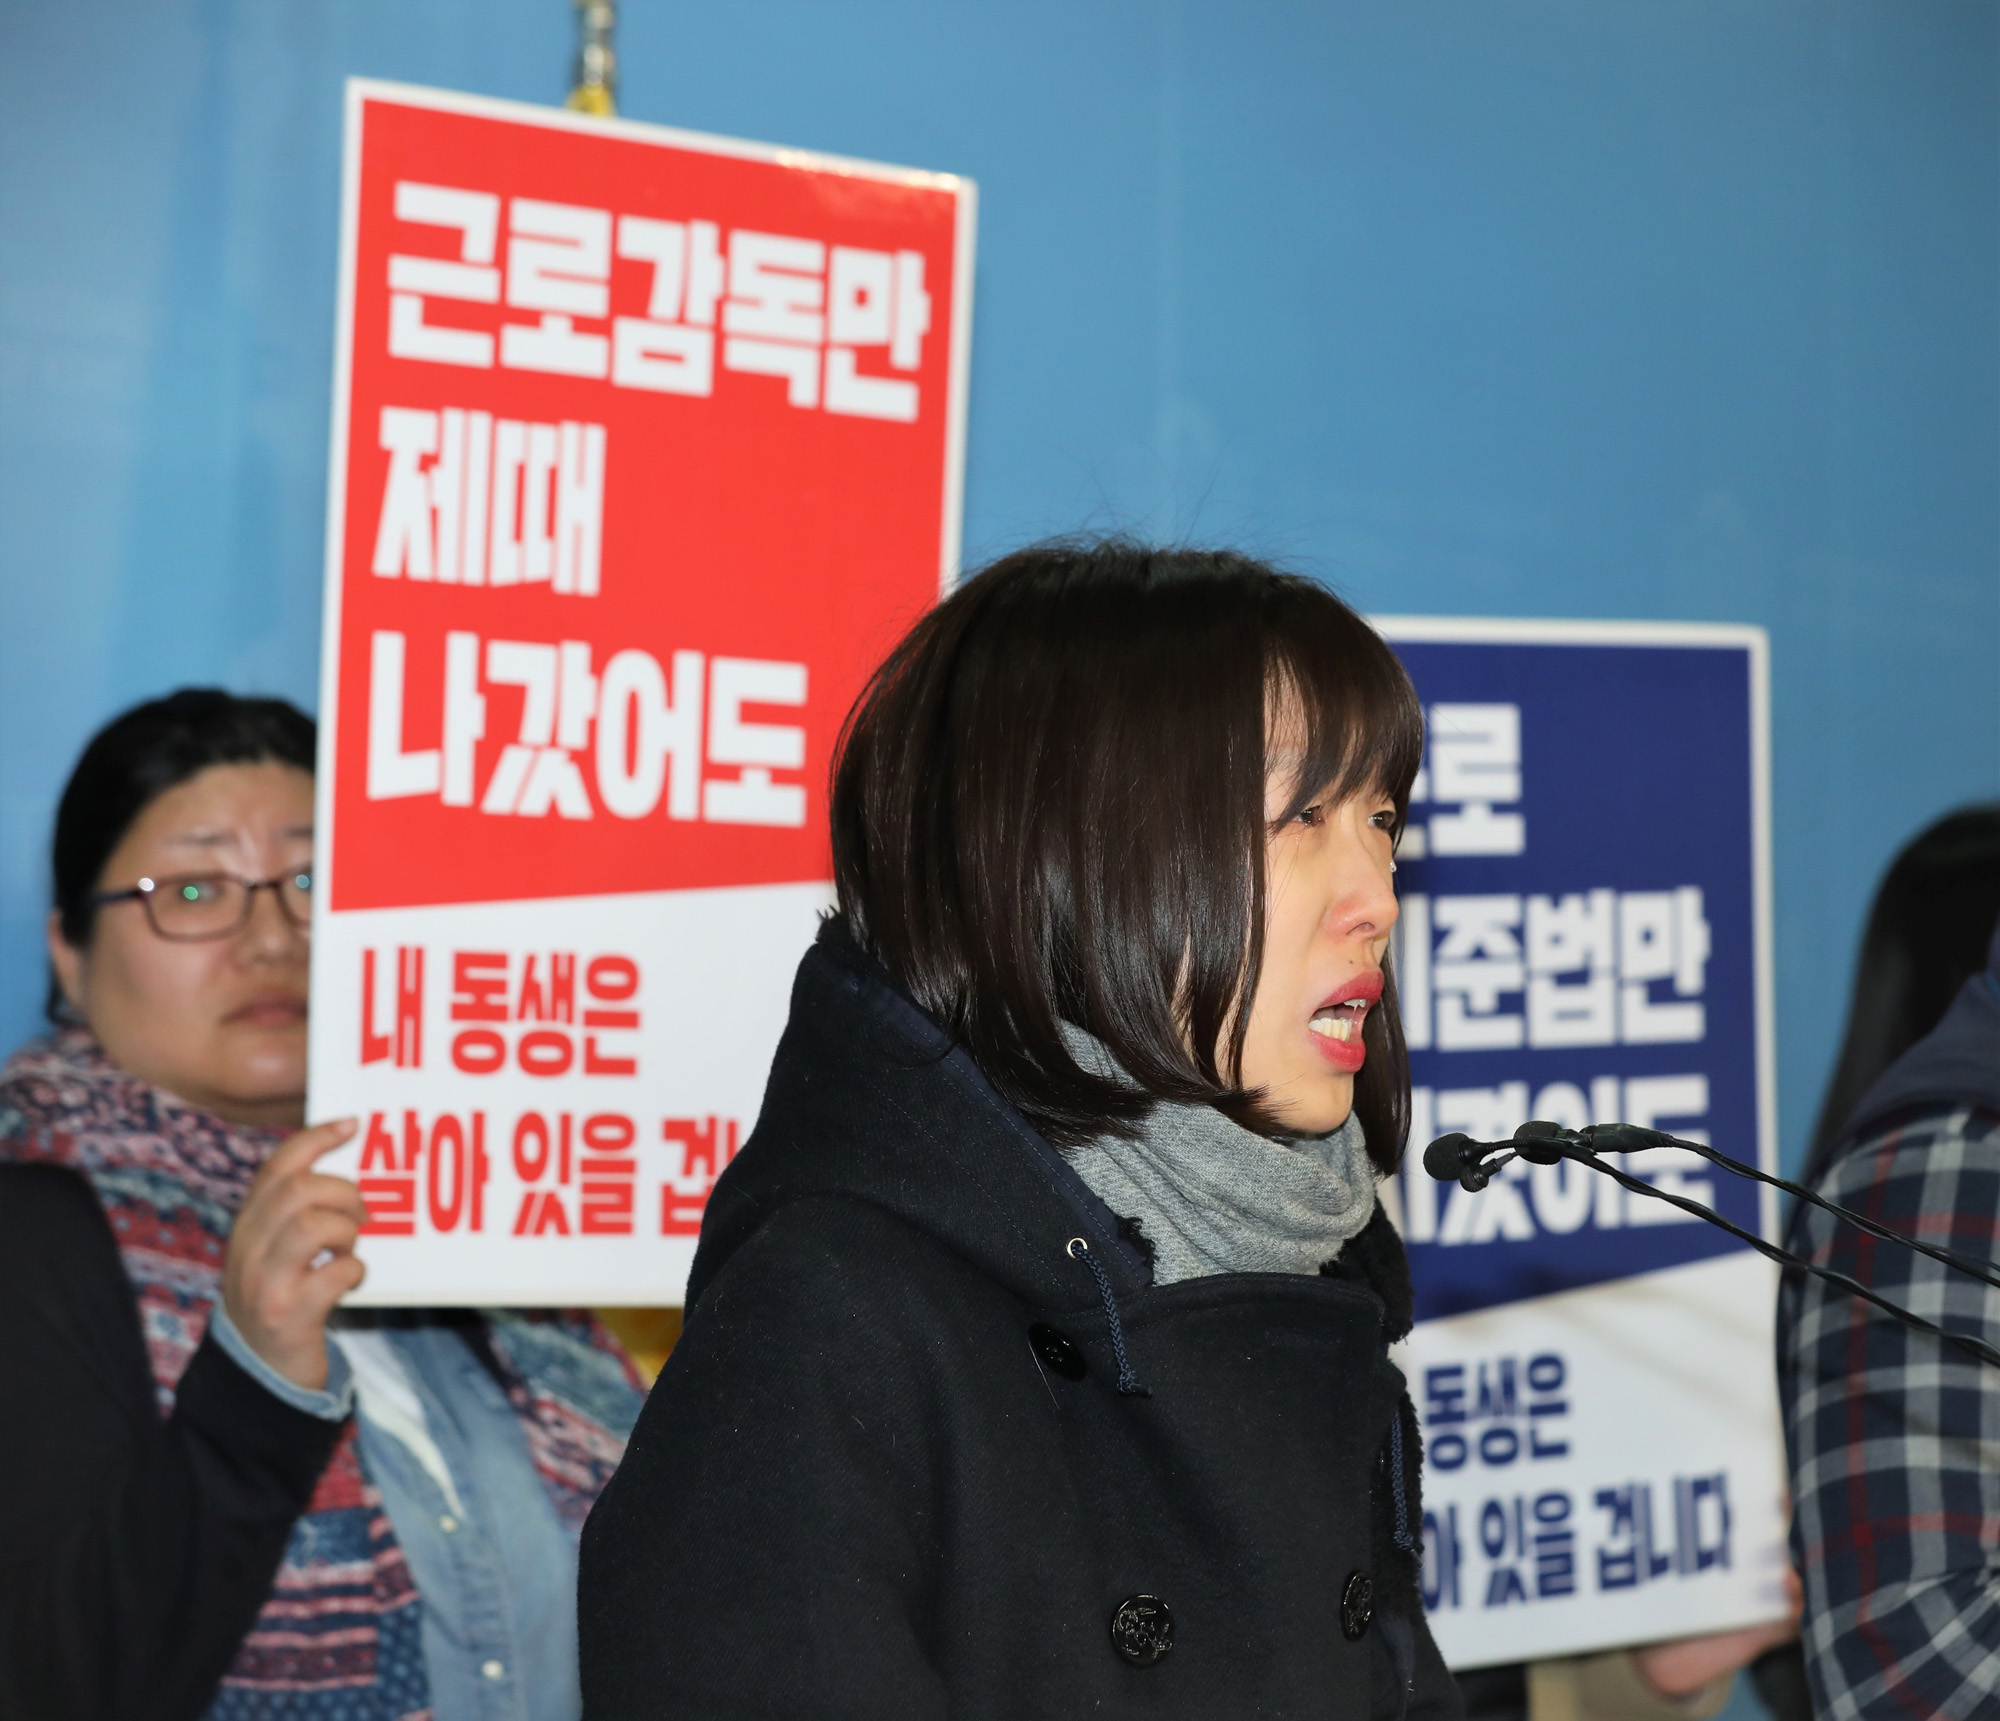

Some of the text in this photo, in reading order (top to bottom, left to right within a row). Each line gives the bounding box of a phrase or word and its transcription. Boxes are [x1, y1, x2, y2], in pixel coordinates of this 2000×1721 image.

[388, 179, 931, 424] 근로감독만
[371, 405, 607, 598] 제때
[366, 629, 808, 828] 나갔어도
[359, 944, 641, 1079] 내 동생은
[357, 1108, 738, 1238] 살아 있을 겁
[1423, 1352, 1572, 1473] 동생은
[1480, 1491, 1577, 1609] 있을
[1593, 1469, 1734, 1593] 겁니다
